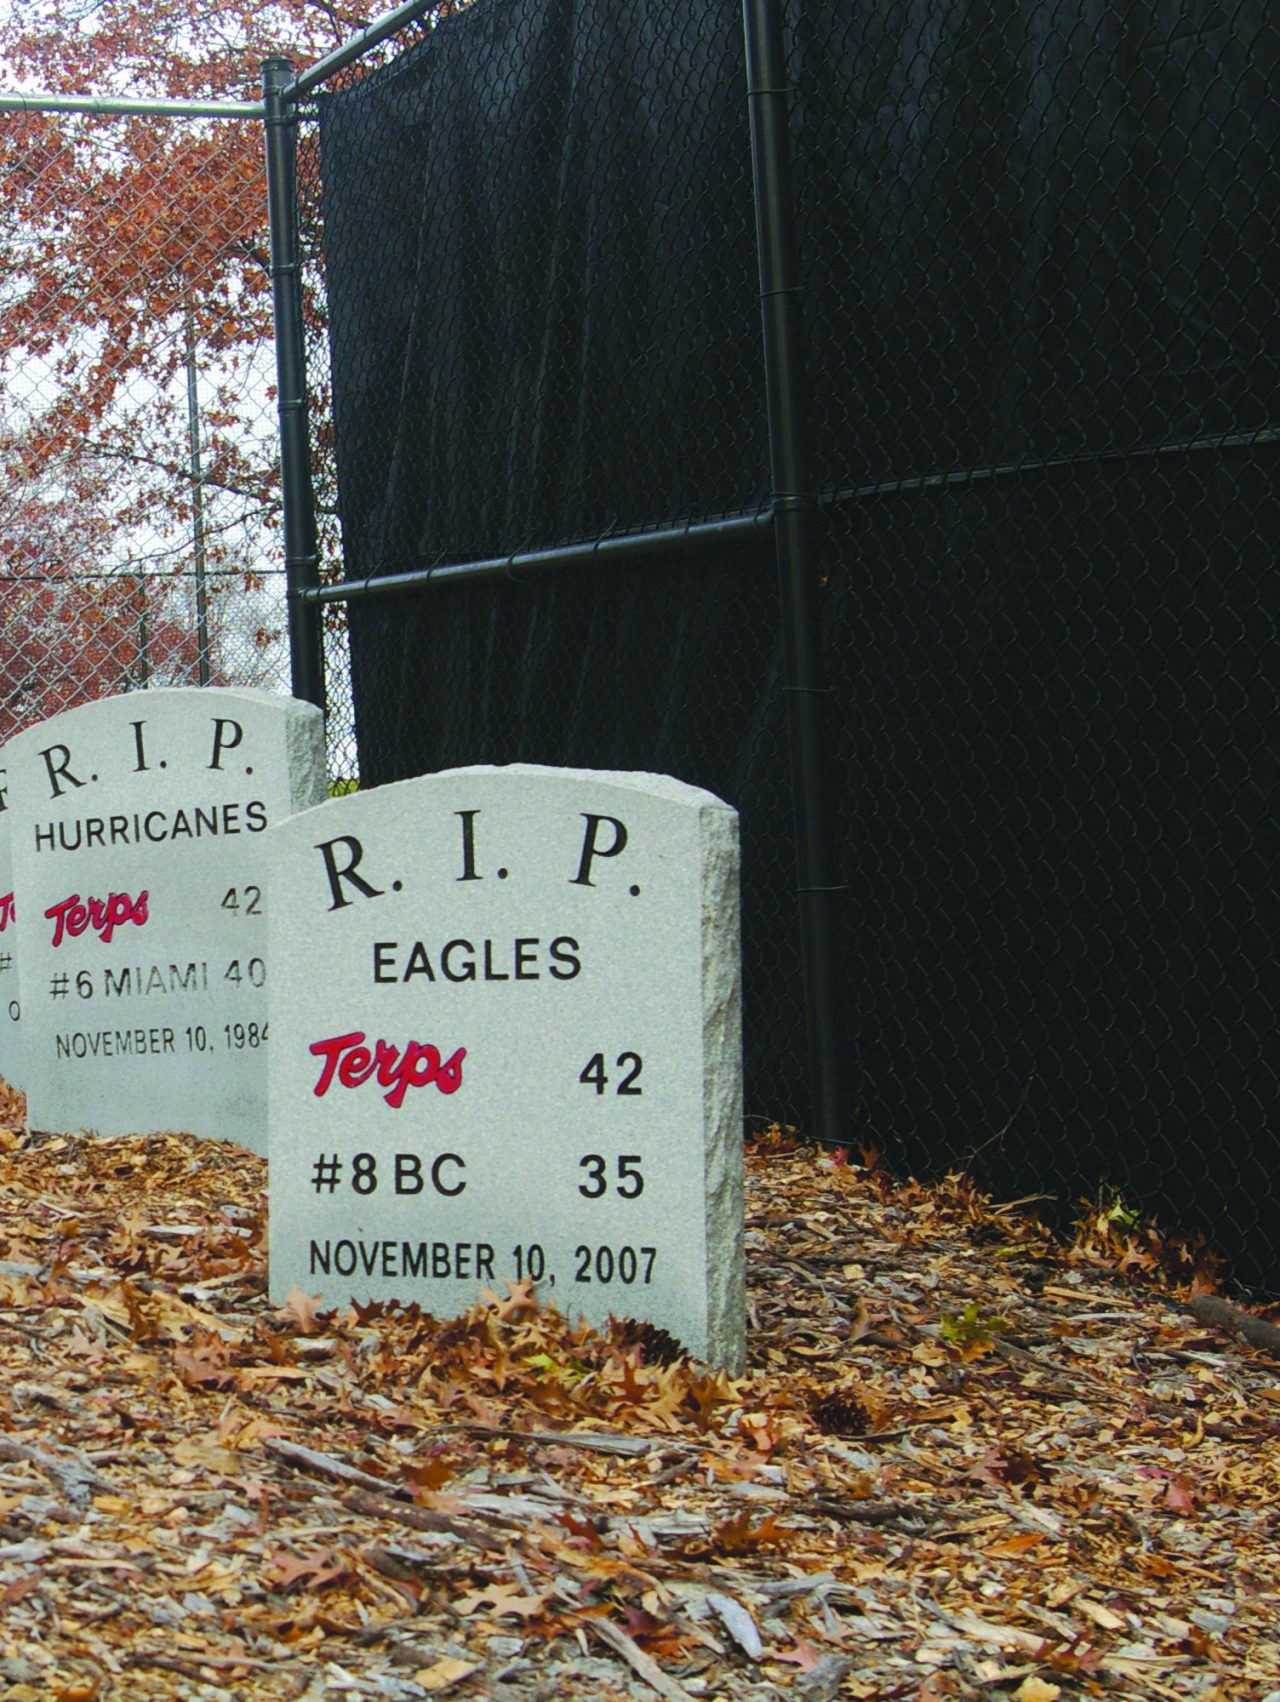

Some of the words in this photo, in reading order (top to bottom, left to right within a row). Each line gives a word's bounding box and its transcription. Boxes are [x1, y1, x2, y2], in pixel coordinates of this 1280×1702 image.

[34, 800, 268, 853] HURRICANES
[43, 889, 150, 948] Terps
[220, 885, 263, 916] 42
[49, 969, 94, 1000] #6
[103, 961, 208, 998] MIAMI
[223, 957, 267, 988] 40
[373, 935, 582, 984] EAGLES
[55, 1027, 175, 1060] NOVEMBER
[308, 1030, 468, 1109] Terps
[579, 1050, 643, 1096] 42
[310, 1152, 378, 1196] #8
[394, 1152, 467, 1197] BC
[578, 1153, 645, 1200] 35
[309, 1239, 496, 1281] NOVEMBER
[512, 1243, 556, 1287] 10,
[574, 1244, 657, 1285] 2007
